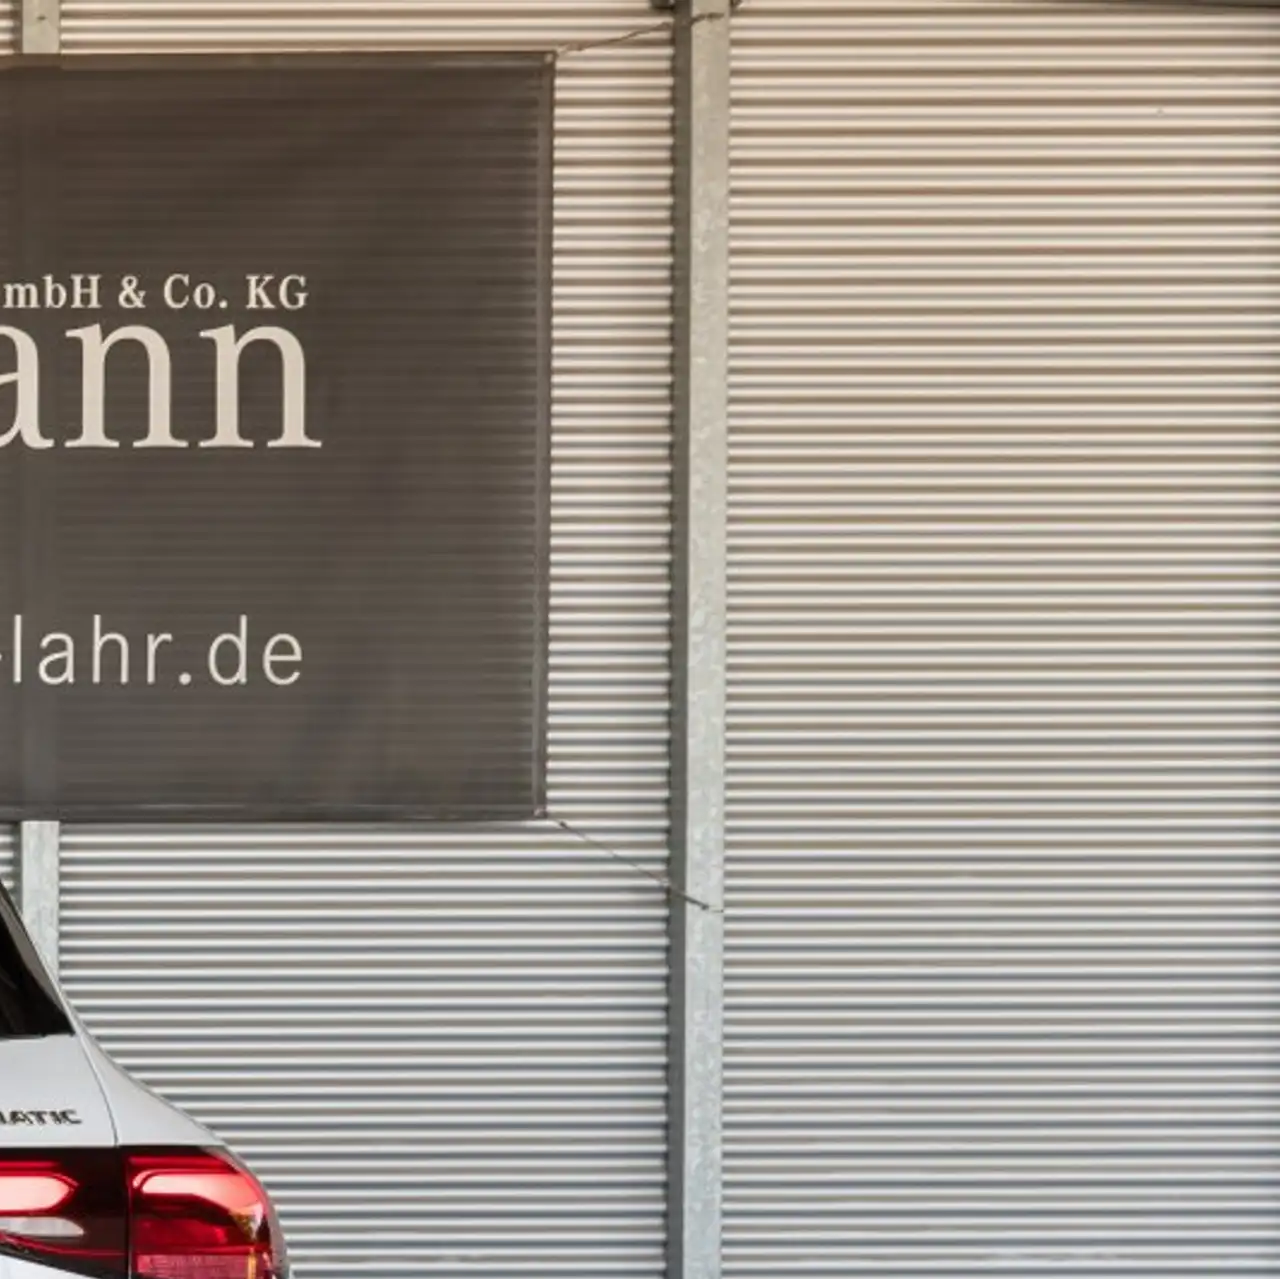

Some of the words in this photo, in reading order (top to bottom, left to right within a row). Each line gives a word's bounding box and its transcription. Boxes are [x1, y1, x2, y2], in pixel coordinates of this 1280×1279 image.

[118, 275, 146, 309] &
[163, 273, 228, 309] Co.
[246, 275, 307, 309] KG
